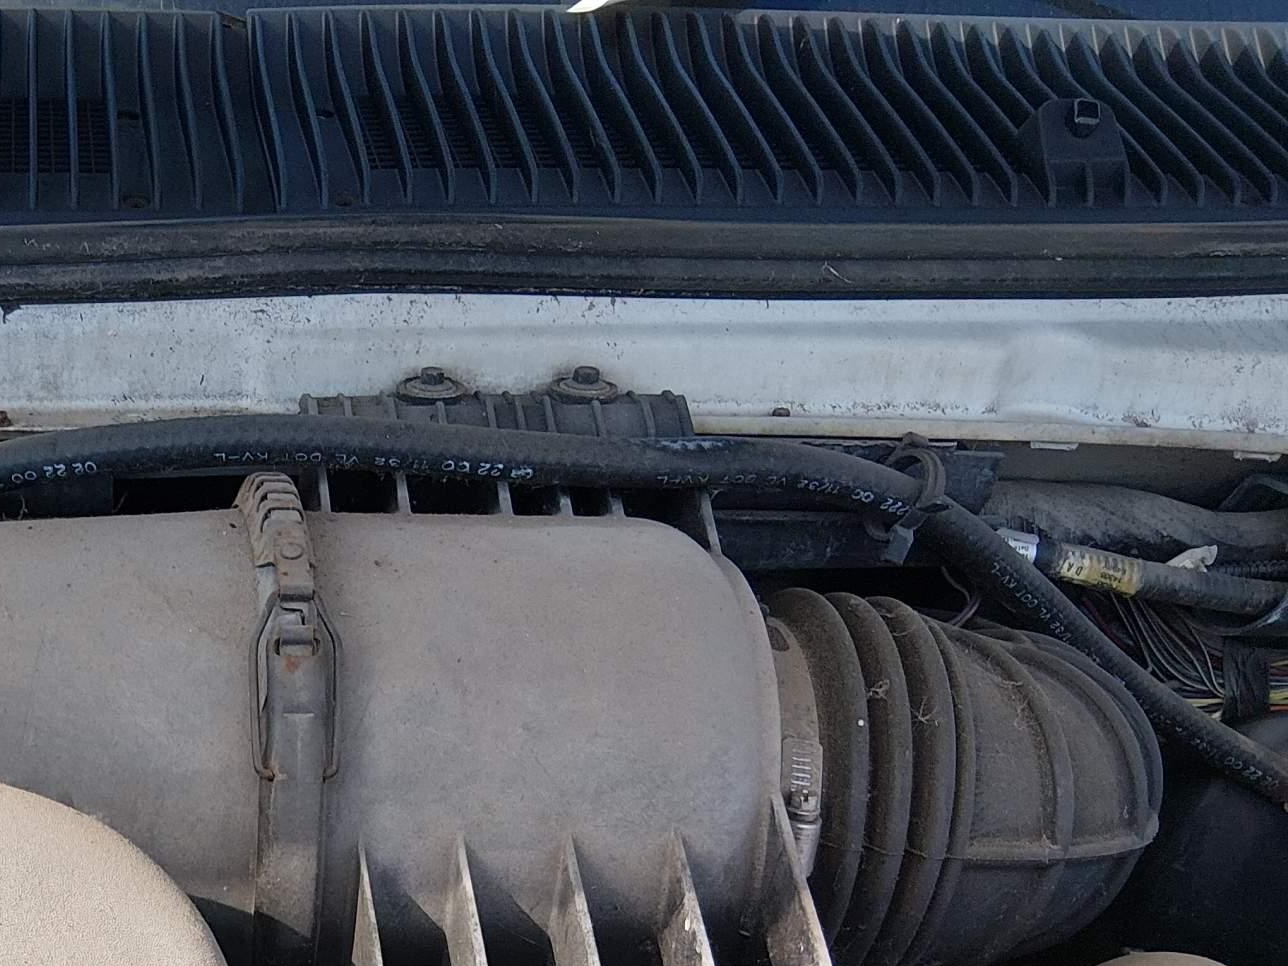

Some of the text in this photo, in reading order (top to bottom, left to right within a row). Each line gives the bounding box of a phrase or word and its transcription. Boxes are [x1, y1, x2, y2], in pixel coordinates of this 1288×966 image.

[43, 463, 67, 478] 22
[71, 460, 97, 474] 02
[11, 470, 38, 484] 00
